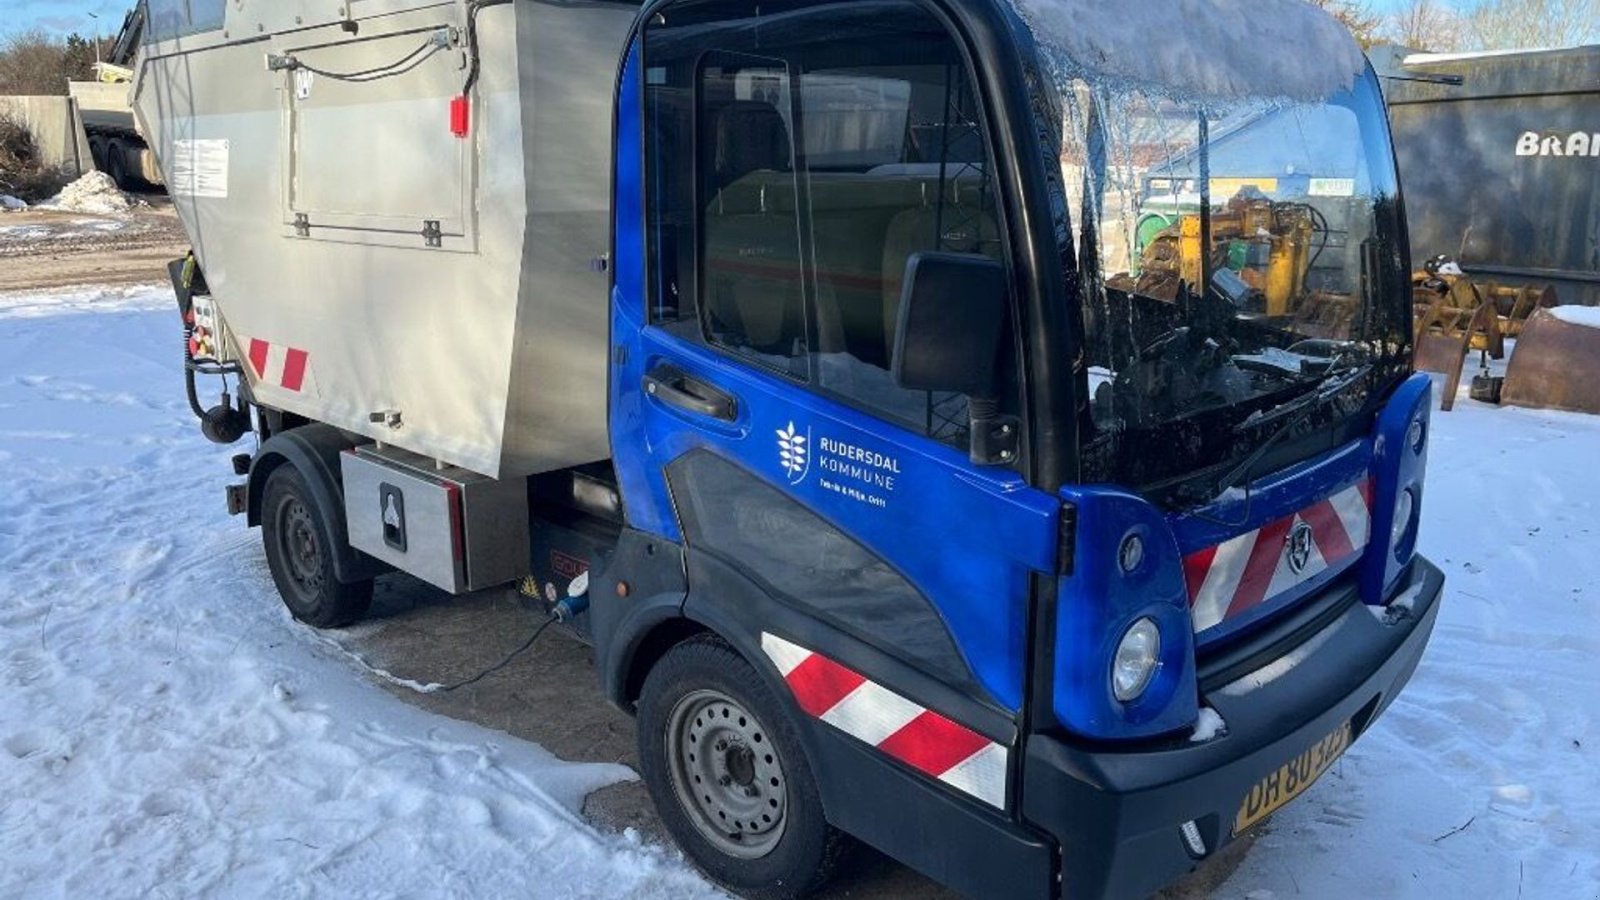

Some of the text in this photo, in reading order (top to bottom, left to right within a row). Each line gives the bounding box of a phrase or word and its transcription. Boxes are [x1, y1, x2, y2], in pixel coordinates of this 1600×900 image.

[820, 437, 901, 473] RUDERSDAL
[820, 456, 895, 490] KOMMUNE
[1246, 770, 1280, 818] DH
[1285, 750, 1312, 793] 80
